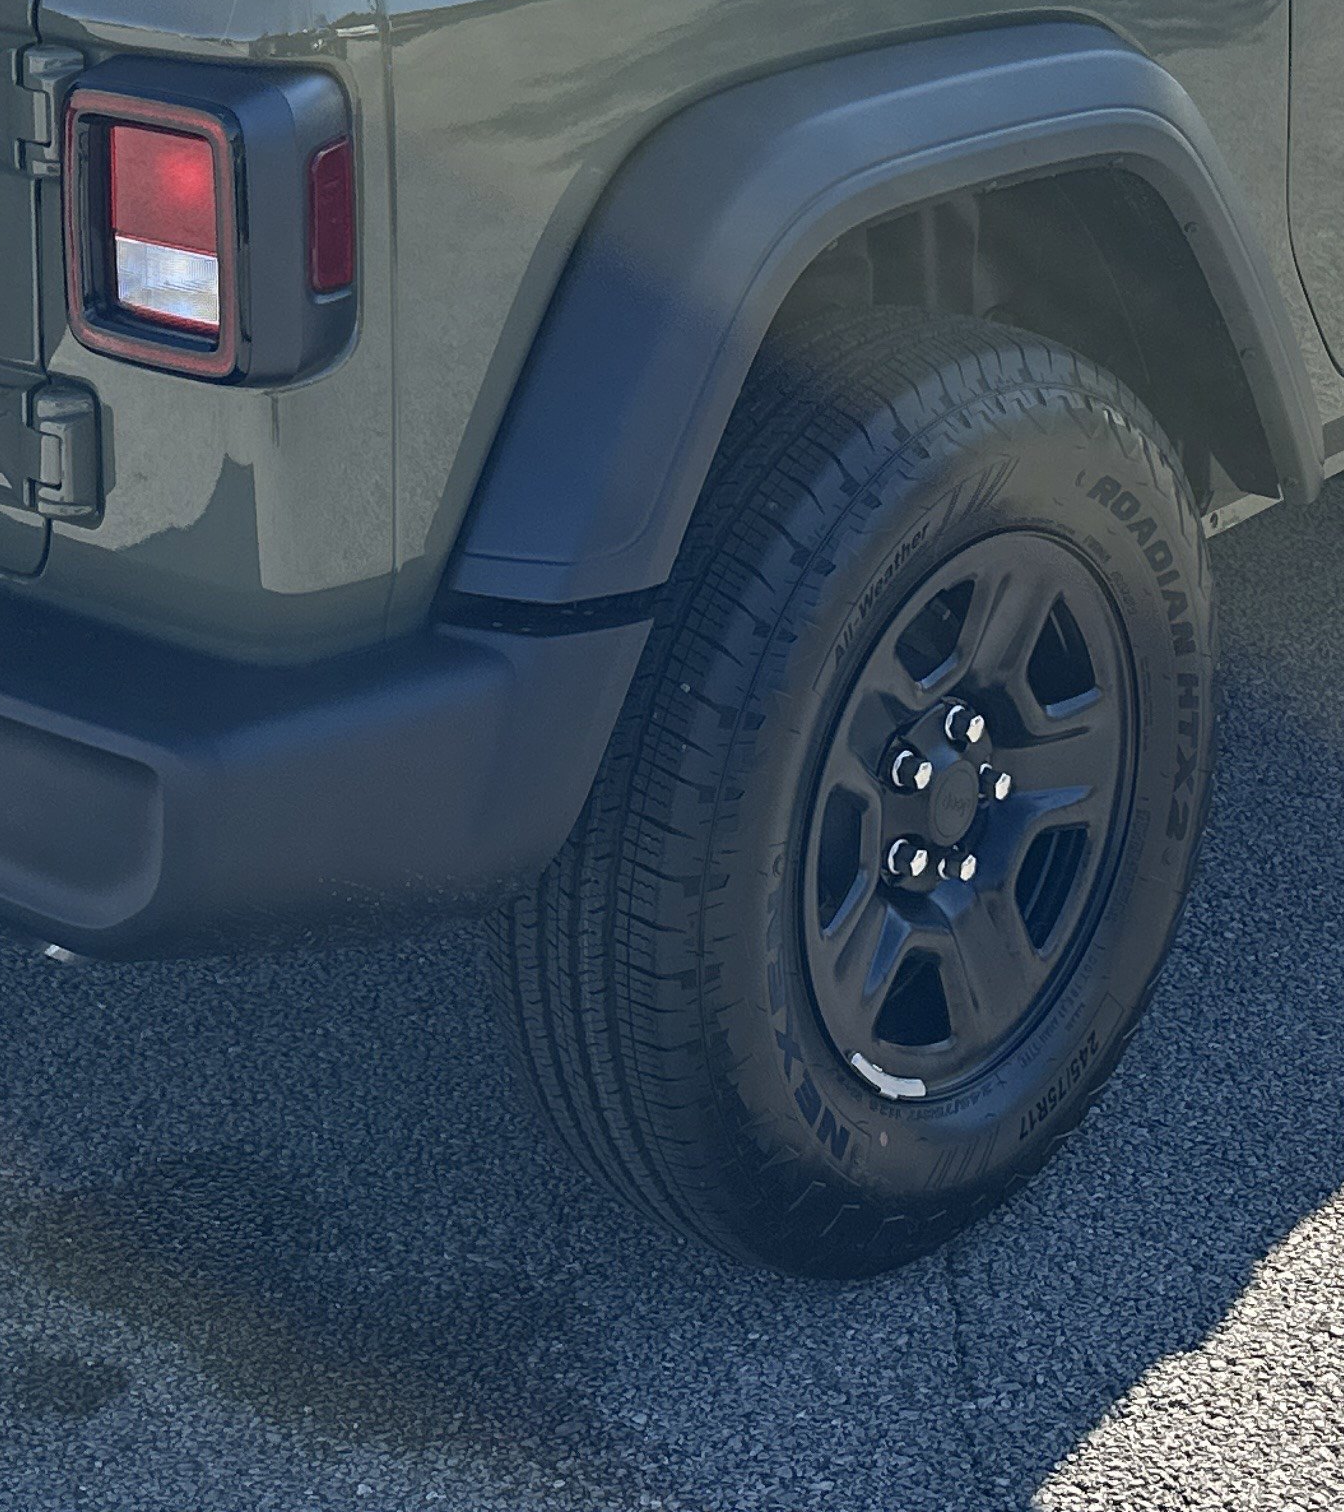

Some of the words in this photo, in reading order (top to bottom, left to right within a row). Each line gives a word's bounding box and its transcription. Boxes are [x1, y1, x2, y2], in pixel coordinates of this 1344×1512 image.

[834, 521, 931, 670] All-Weather
[1086, 474, 1198, 658] ROADIAN
[1165, 672, 1200, 842] HTX2
[1018, 1029, 1101, 1141] 245/75R17
